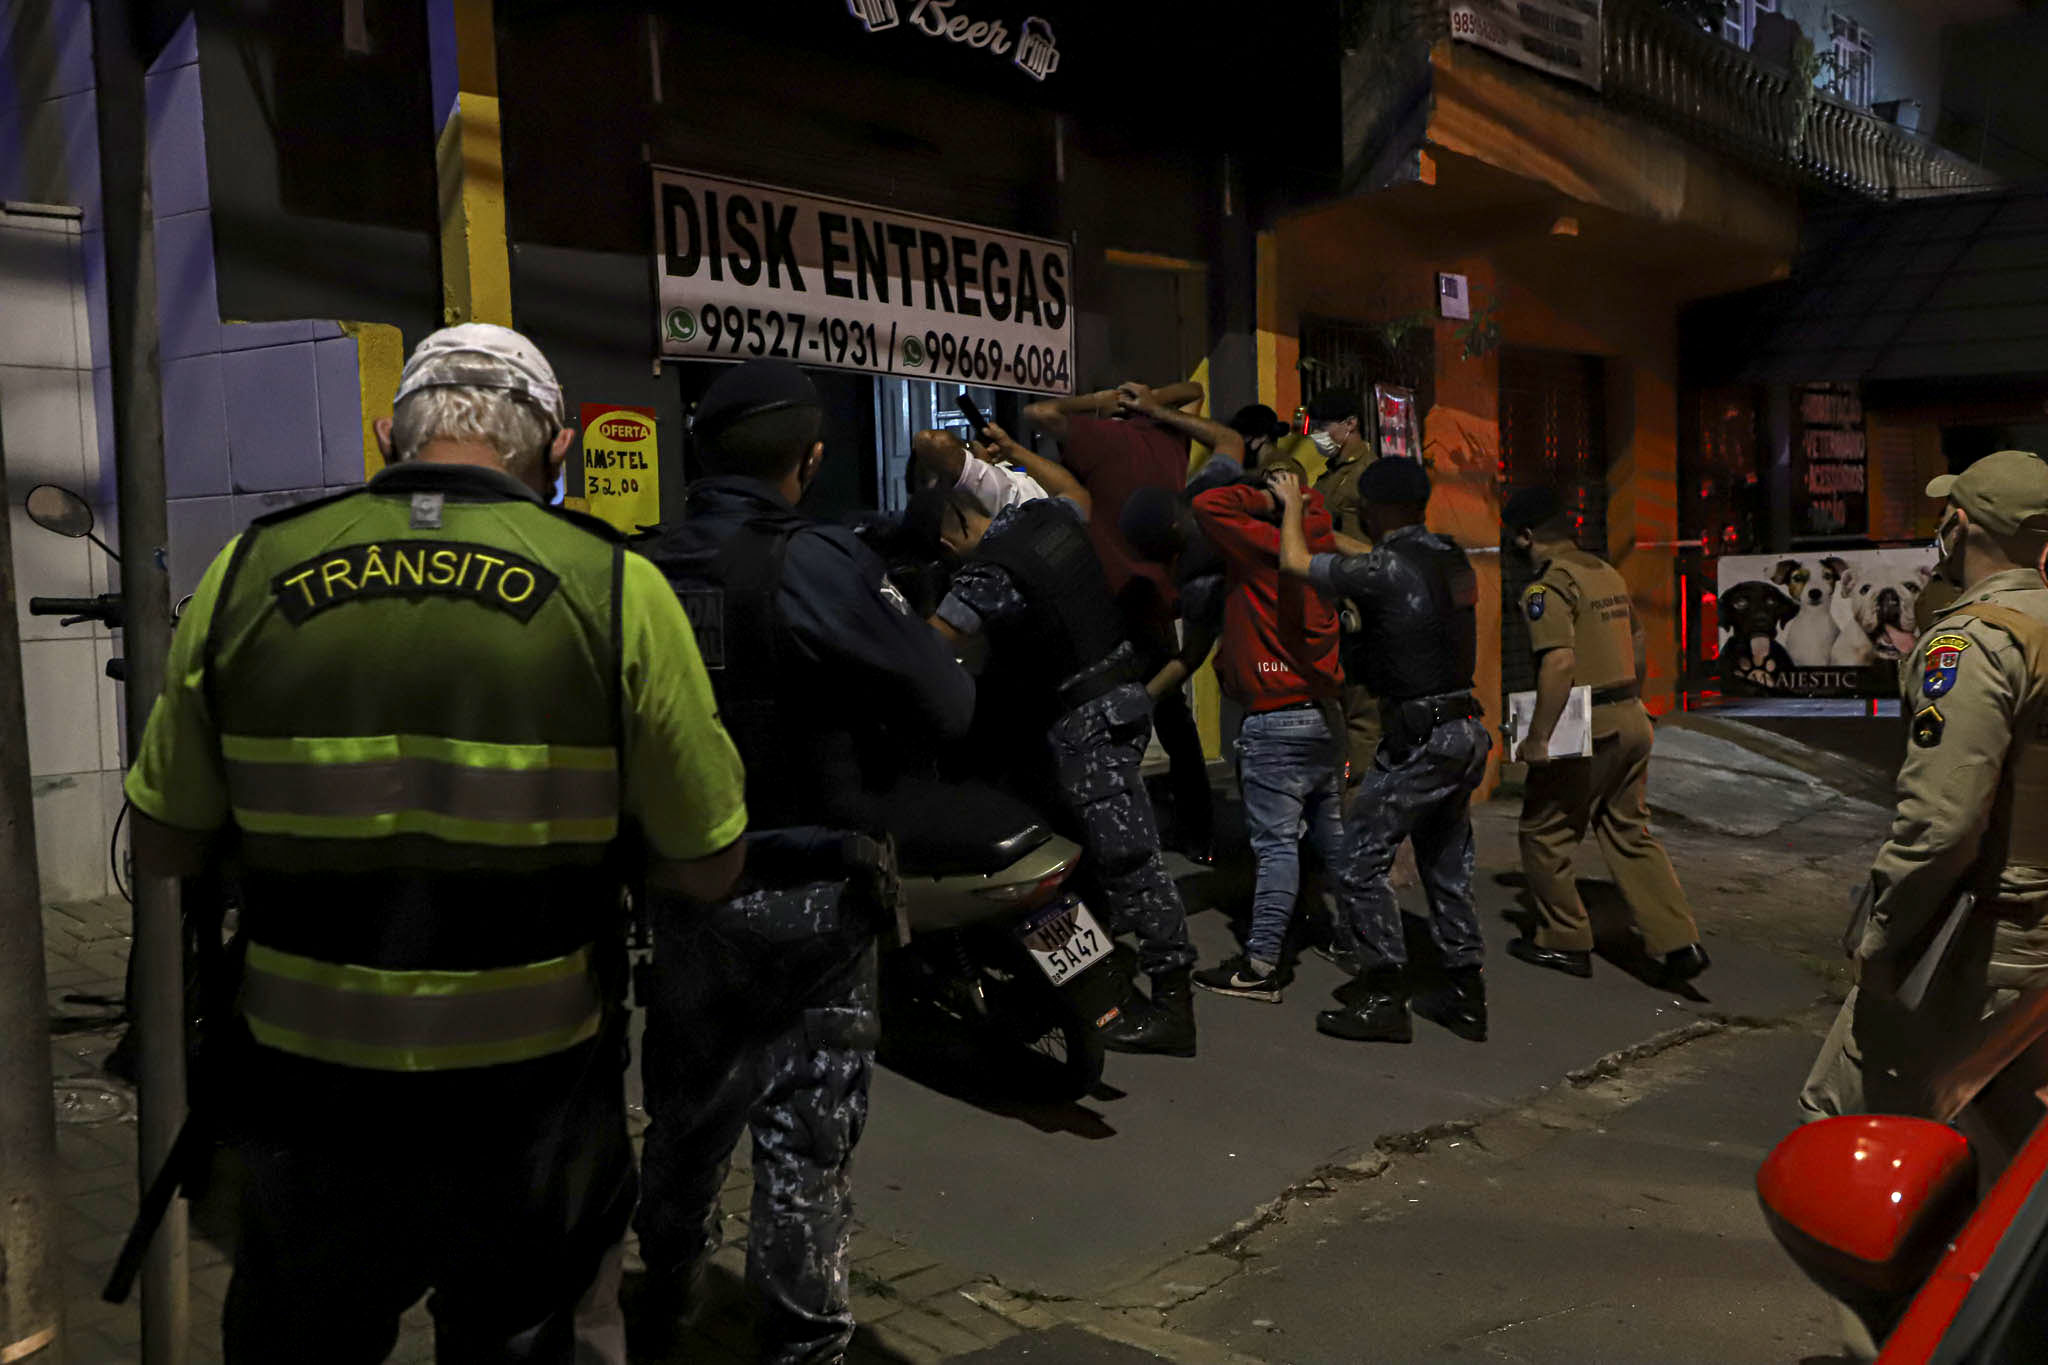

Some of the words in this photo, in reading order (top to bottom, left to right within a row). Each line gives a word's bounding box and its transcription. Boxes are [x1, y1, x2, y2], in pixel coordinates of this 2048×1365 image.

[909, 0, 1012, 54] Beer
[662, 184, 806, 292] DISK
[818, 211, 1066, 330] ENTREGAS
[701, 303, 879, 368] 99527-1931
[925, 330, 1069, 389] 99669-6084
[601, 424, 651, 438] OFERTA
[586, 448, 648, 469] AMSTEL
[283, 544, 536, 607] TRÂNSITO
[1258, 661, 1289, 672] ICON
[1038, 912, 1083, 950] MHK
[1048, 929, 1098, 973] 5A47
